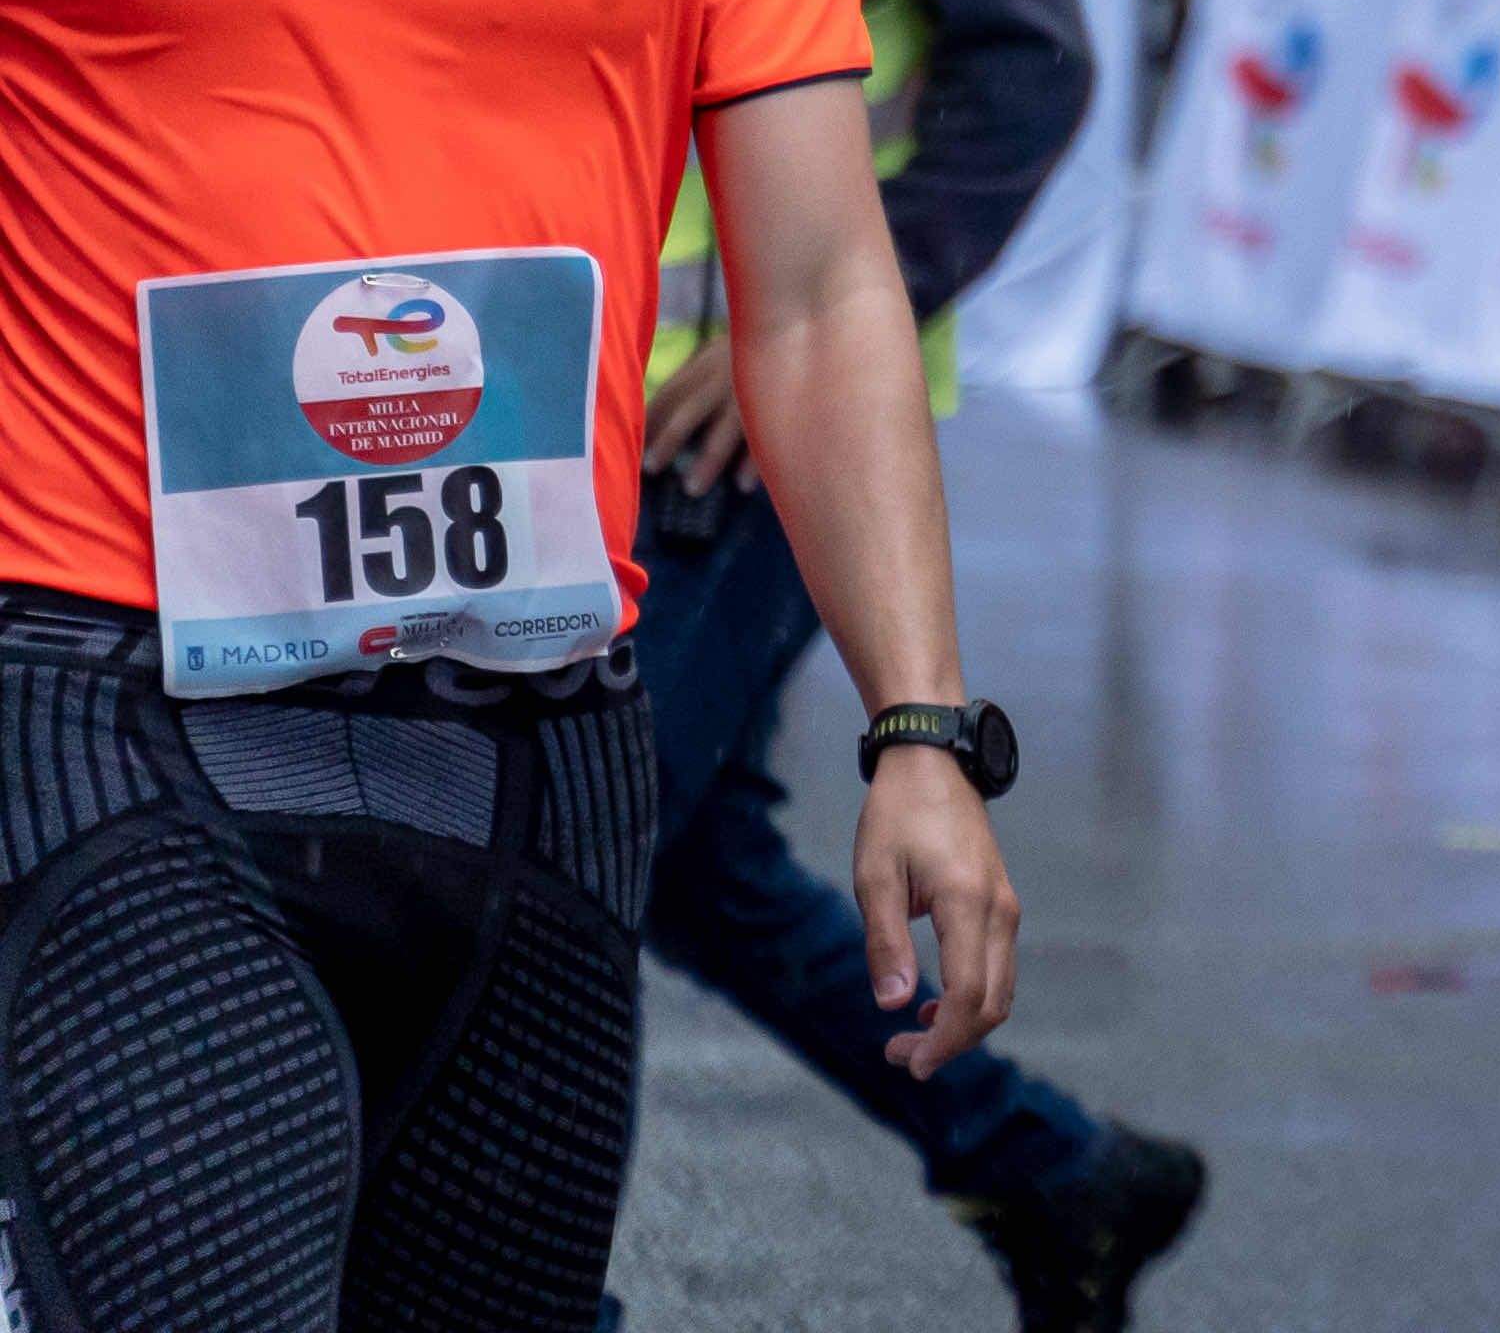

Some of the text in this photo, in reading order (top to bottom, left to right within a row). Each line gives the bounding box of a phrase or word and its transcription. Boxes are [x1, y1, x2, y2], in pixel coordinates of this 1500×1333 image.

[338, 364, 451, 386] TotalEnergies
[367, 399, 422, 416] MILLA
[351, 431, 443, 452] DE MADRID
[295, 466, 509, 603] 158
[220, 640, 329, 666] MADRID
